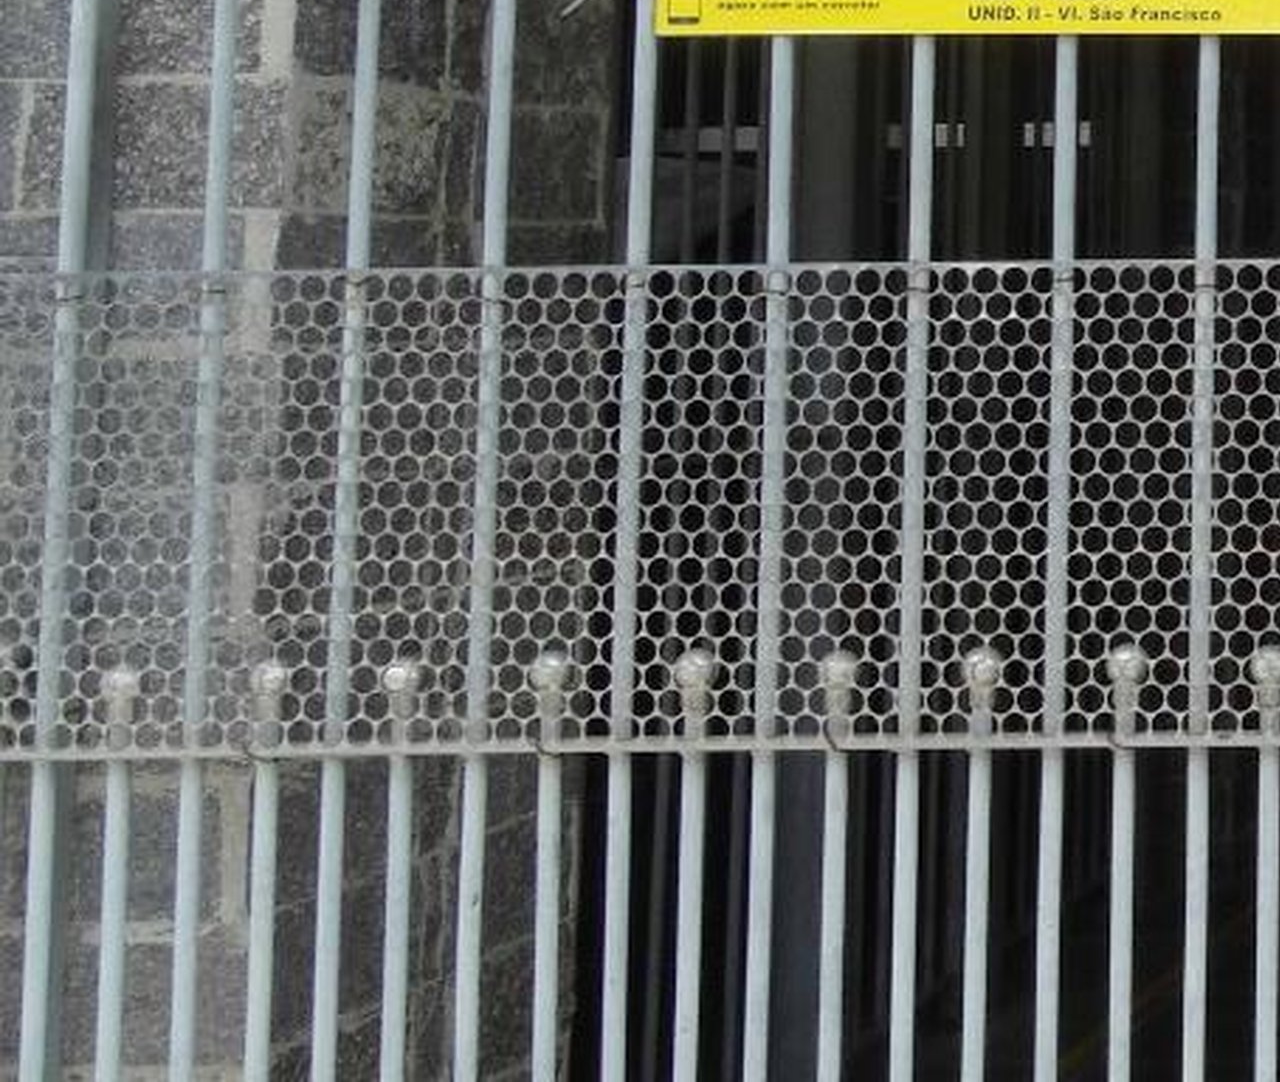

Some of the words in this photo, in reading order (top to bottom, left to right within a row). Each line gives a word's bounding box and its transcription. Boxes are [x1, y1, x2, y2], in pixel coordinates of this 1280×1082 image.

[968, 7, 1021, 21] UNID.
[1090, 5, 1123, 21] São
[1130, 6, 1222, 21] Francisco
